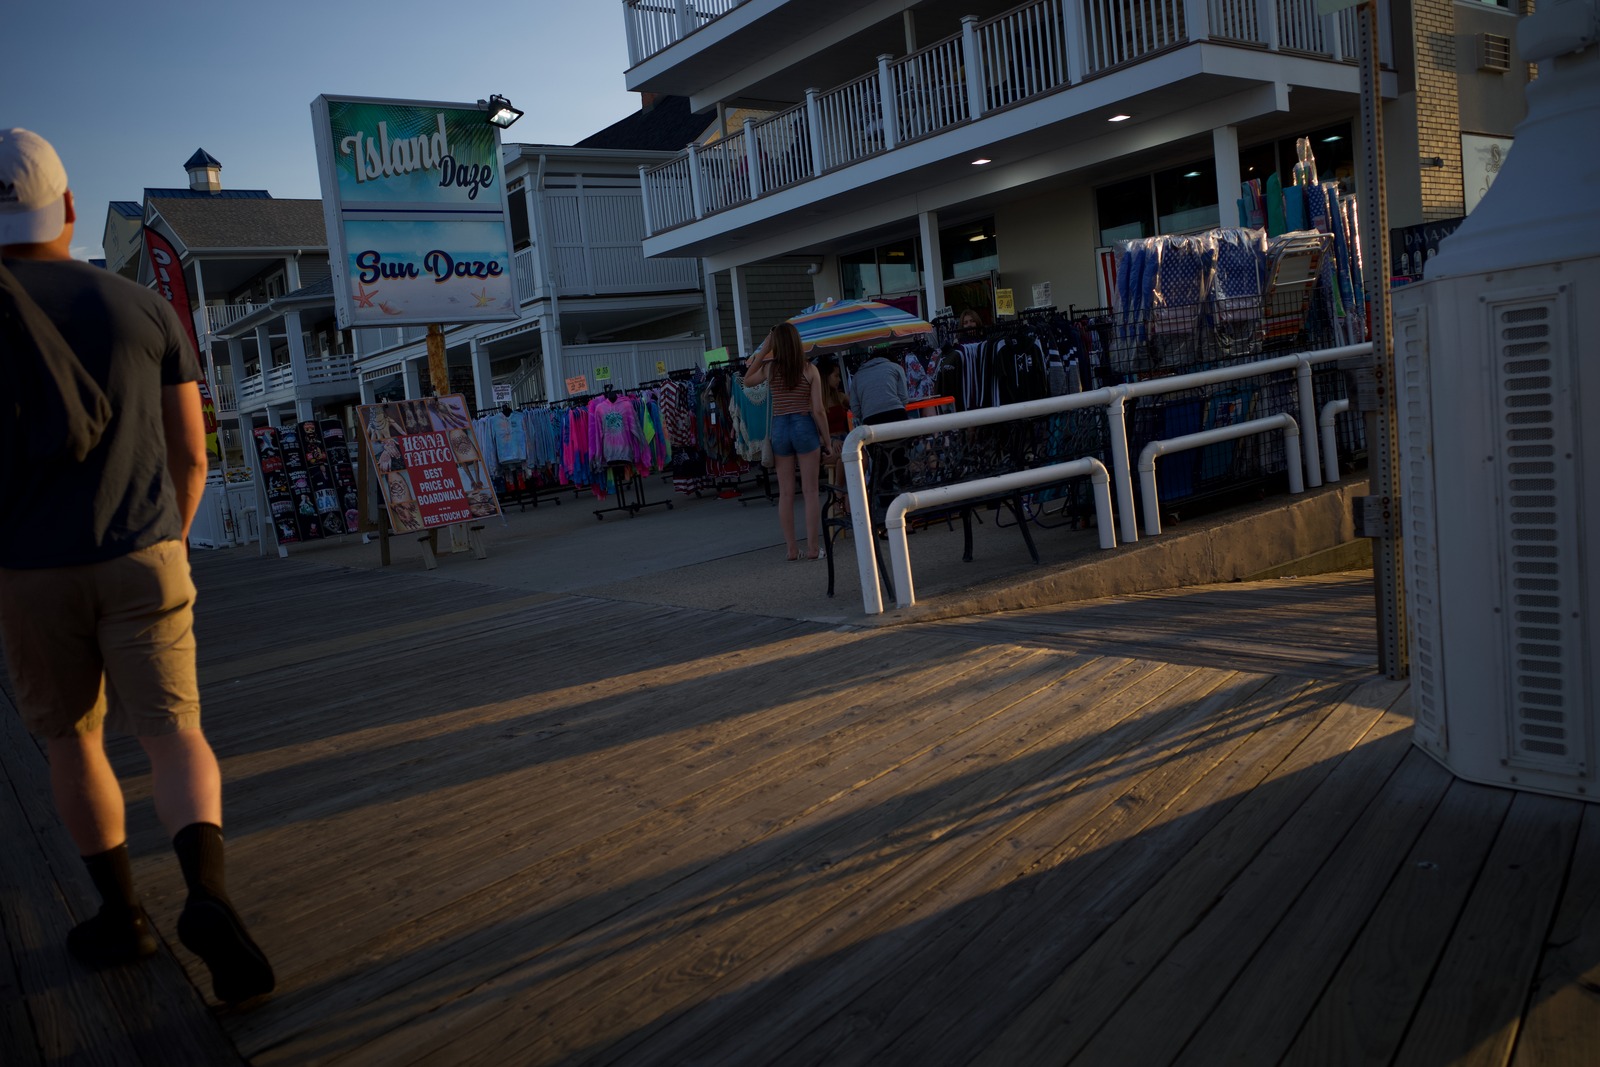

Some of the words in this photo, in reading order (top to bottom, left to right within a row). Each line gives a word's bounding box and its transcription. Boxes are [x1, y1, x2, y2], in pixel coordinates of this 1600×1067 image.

[339, 113, 453, 184] Island
[438, 154, 494, 200] Daze
[356, 249, 419, 284] Sun
[424, 249, 503, 283] Daze
[402, 433, 446, 451] HENNA
[405, 448, 452, 468] TATTOO
[425, 468, 443, 479] BEST
[419, 480, 442, 493] PRICE
[443, 478, 455, 489] ON
[418, 490, 464, 505] BOARDWALK
[424, 515, 440, 525] FREE
[440, 512, 461, 523] TOUCH
[461, 509, 470, 520] UP
